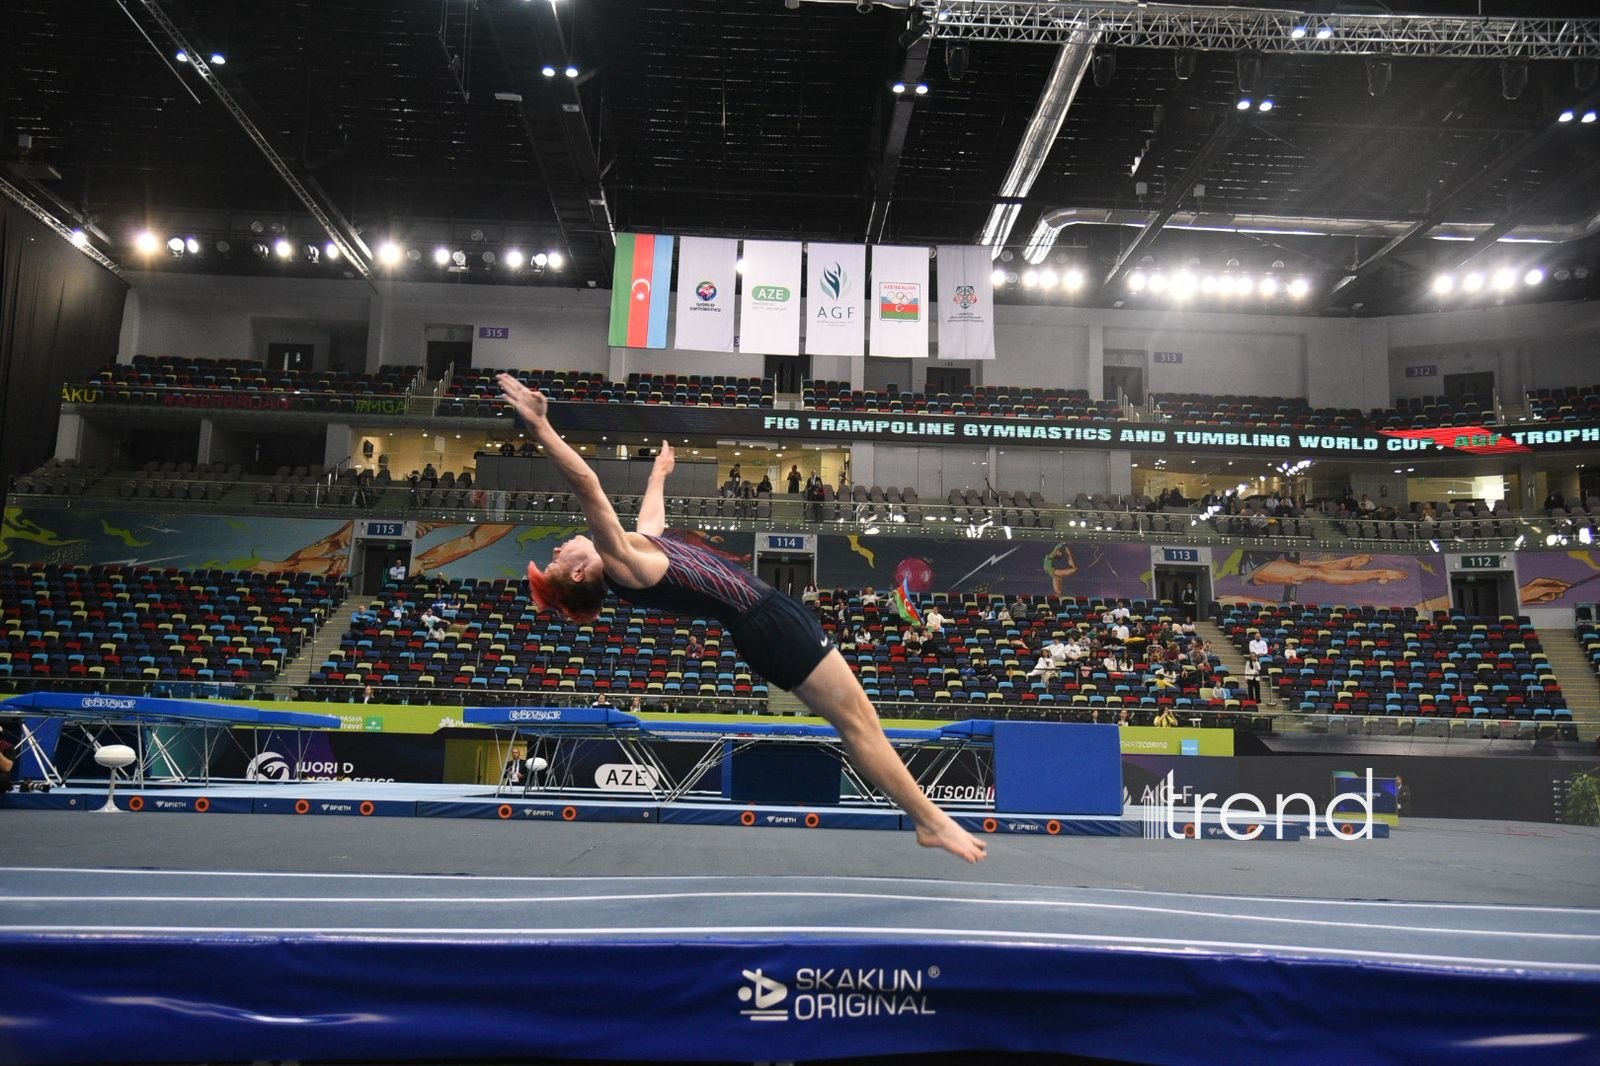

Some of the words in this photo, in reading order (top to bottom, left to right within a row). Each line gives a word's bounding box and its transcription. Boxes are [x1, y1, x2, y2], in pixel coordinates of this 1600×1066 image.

[757, 288, 784, 300] AZE
[485, 328, 503, 338] 315
[1160, 353, 1177, 362] 313
[763, 416, 800, 430] FIG
[808, 417, 955, 436] TRAMPOLINE
[963, 423, 1112, 442] GYMNASTICS
[1120, 429, 1167, 443] AND
[1174, 431, 1291, 448] TUMBLING
[1299, 436, 1379, 451] WORLD
[1511, 427, 1600, 445] TROPH
[375, 524, 396, 535] 115
[776, 537, 796, 548] 114
[1171, 549, 1191, 561] 113
[1469, 556, 1492, 568] 112
[605, 769, 647, 786] AZE
[164, 801, 187, 809] SPIETH
[329, 804, 352, 812] SPIETH
[532, 809, 554, 817] SPIETH
[775, 816, 798, 824] SPIETH
[1016, 823, 1039, 831] SPIETH
[796, 968, 922, 992] SKAKUN
[795, 993, 936, 1020] ORIGINAL
